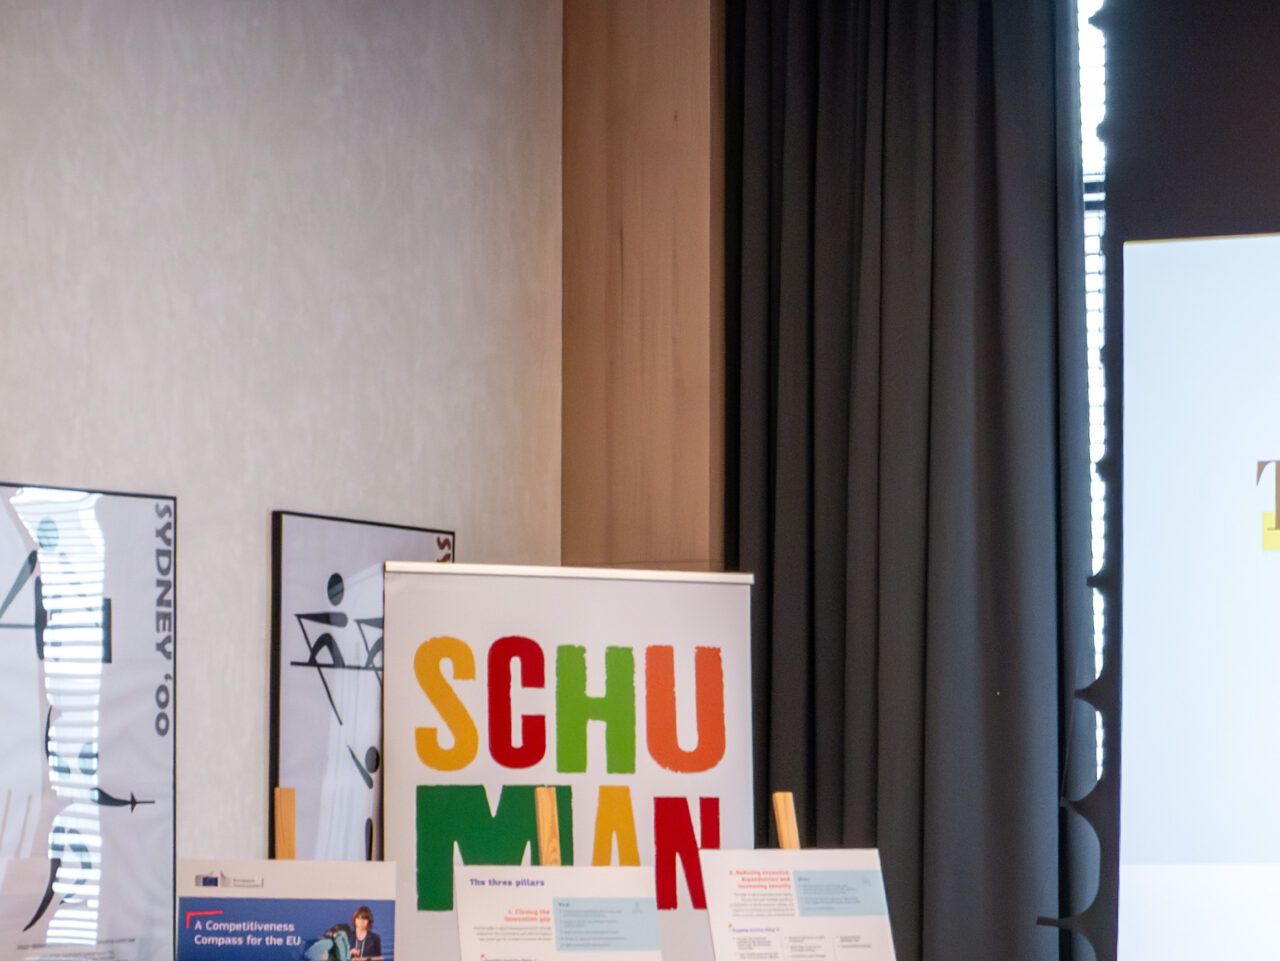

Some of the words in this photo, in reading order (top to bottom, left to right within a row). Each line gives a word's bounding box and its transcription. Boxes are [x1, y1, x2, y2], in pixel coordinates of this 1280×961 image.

[155, 503, 172, 661] SYDNEY
[413, 635, 727, 774] SCHU
[488, 878, 513, 887] three
[515, 878, 545, 888] pillars
[194, 920, 203, 931] A
[205, 920, 296, 933] Competitiveness
[194, 934, 244, 947] Compass
[246, 934, 263, 945] for
[264, 935, 284, 946] the
[285, 935, 302, 946] EU
